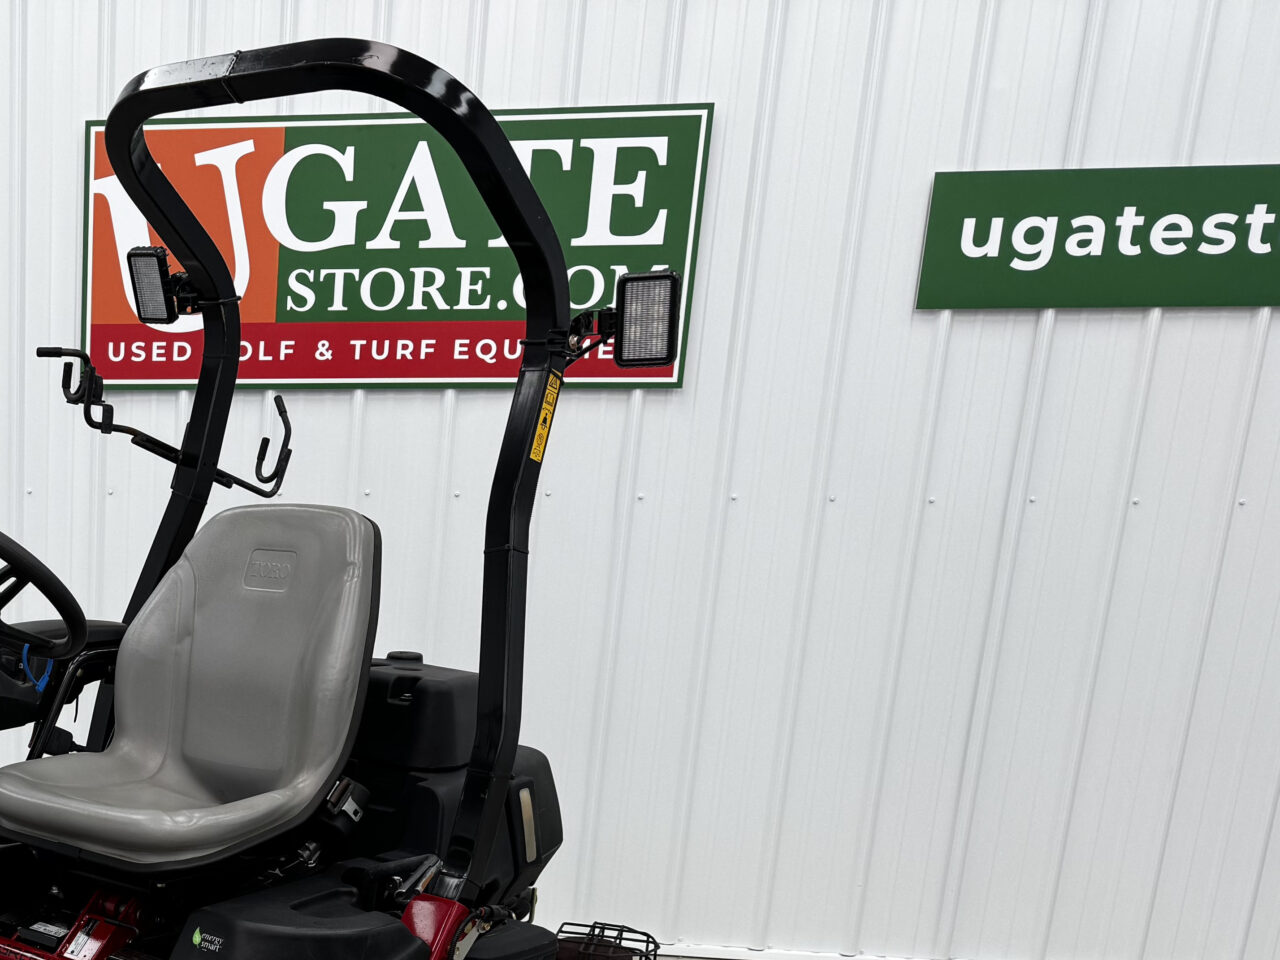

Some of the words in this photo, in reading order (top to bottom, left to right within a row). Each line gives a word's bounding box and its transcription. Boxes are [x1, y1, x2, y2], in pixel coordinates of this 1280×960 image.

[960, 203, 1276, 271] ugatest
[286, 264, 669, 312] STORE.O
[108, 341, 192, 362] USED
[239, 340, 296, 362] OLF
[315, 340, 333, 362] &
[355, 339, 436, 361] TURF
[201, 933, 223, 945] energy
